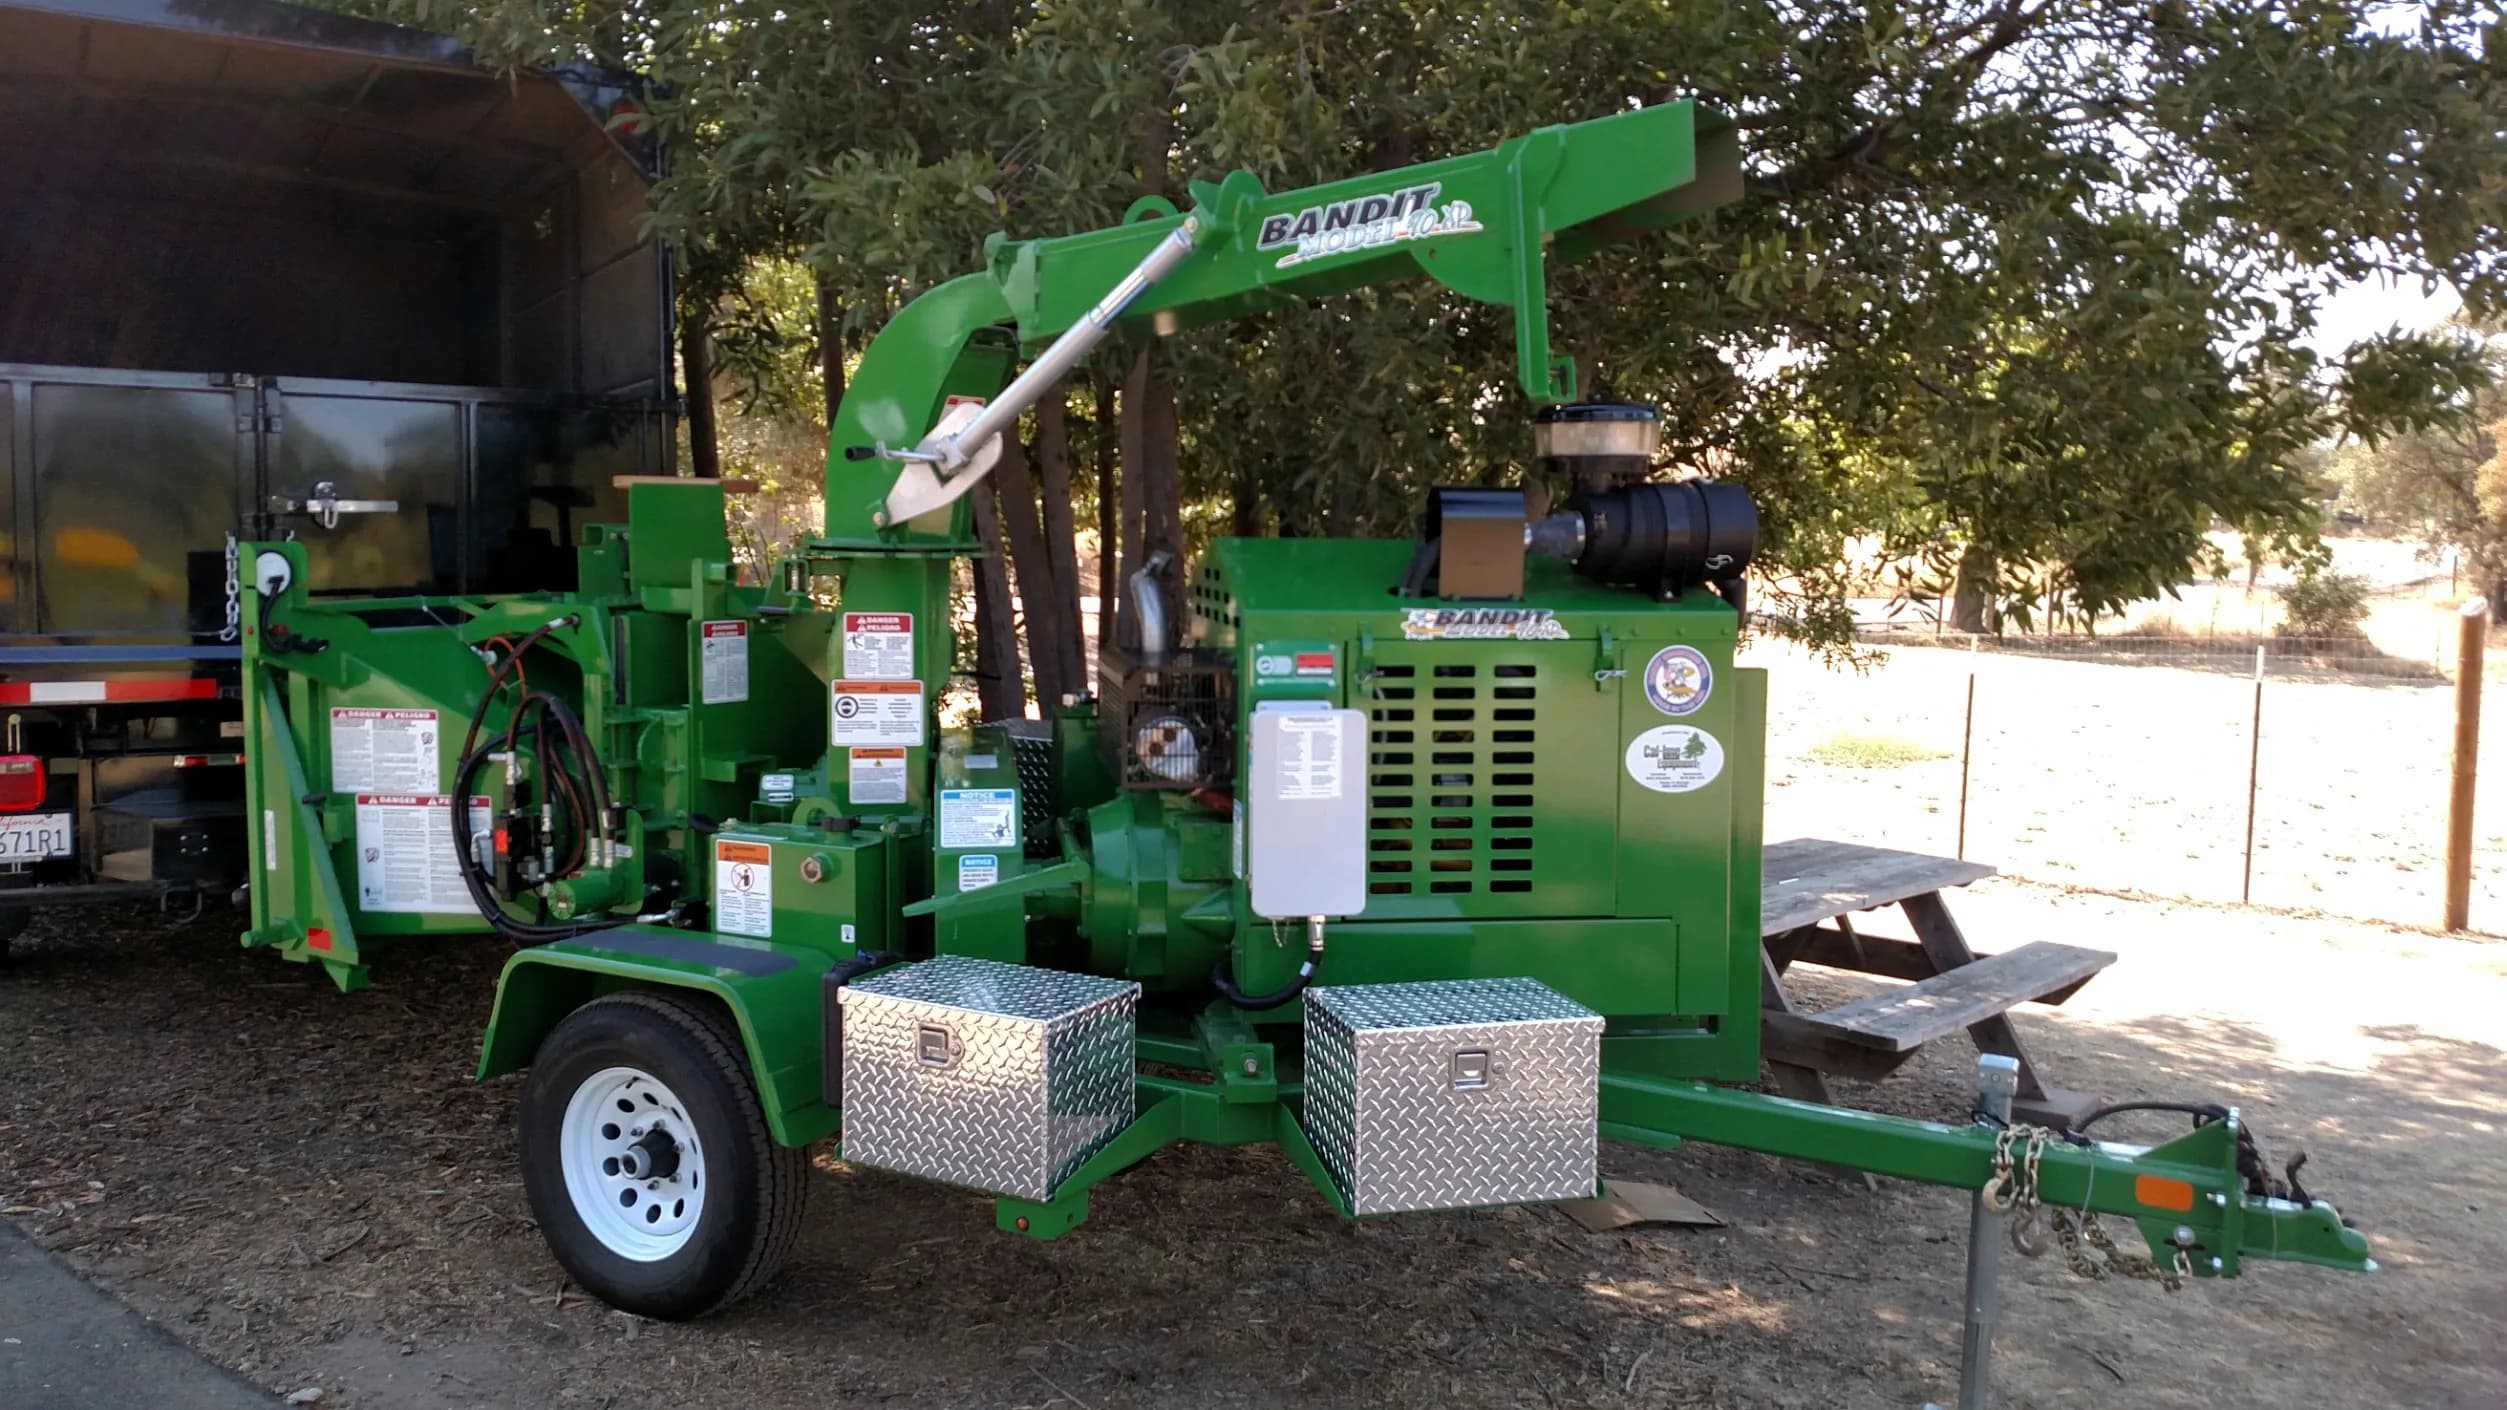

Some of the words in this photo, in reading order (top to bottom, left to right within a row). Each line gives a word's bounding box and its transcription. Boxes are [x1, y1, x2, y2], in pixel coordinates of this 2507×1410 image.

[1259, 185, 1438, 246] BANDIT
[1298, 218, 1396, 258] MODEL
[1434, 609, 1552, 626] BANDIT
[380, 796, 416, 804] DANGER
[960, 791, 995, 800] NOTICE
